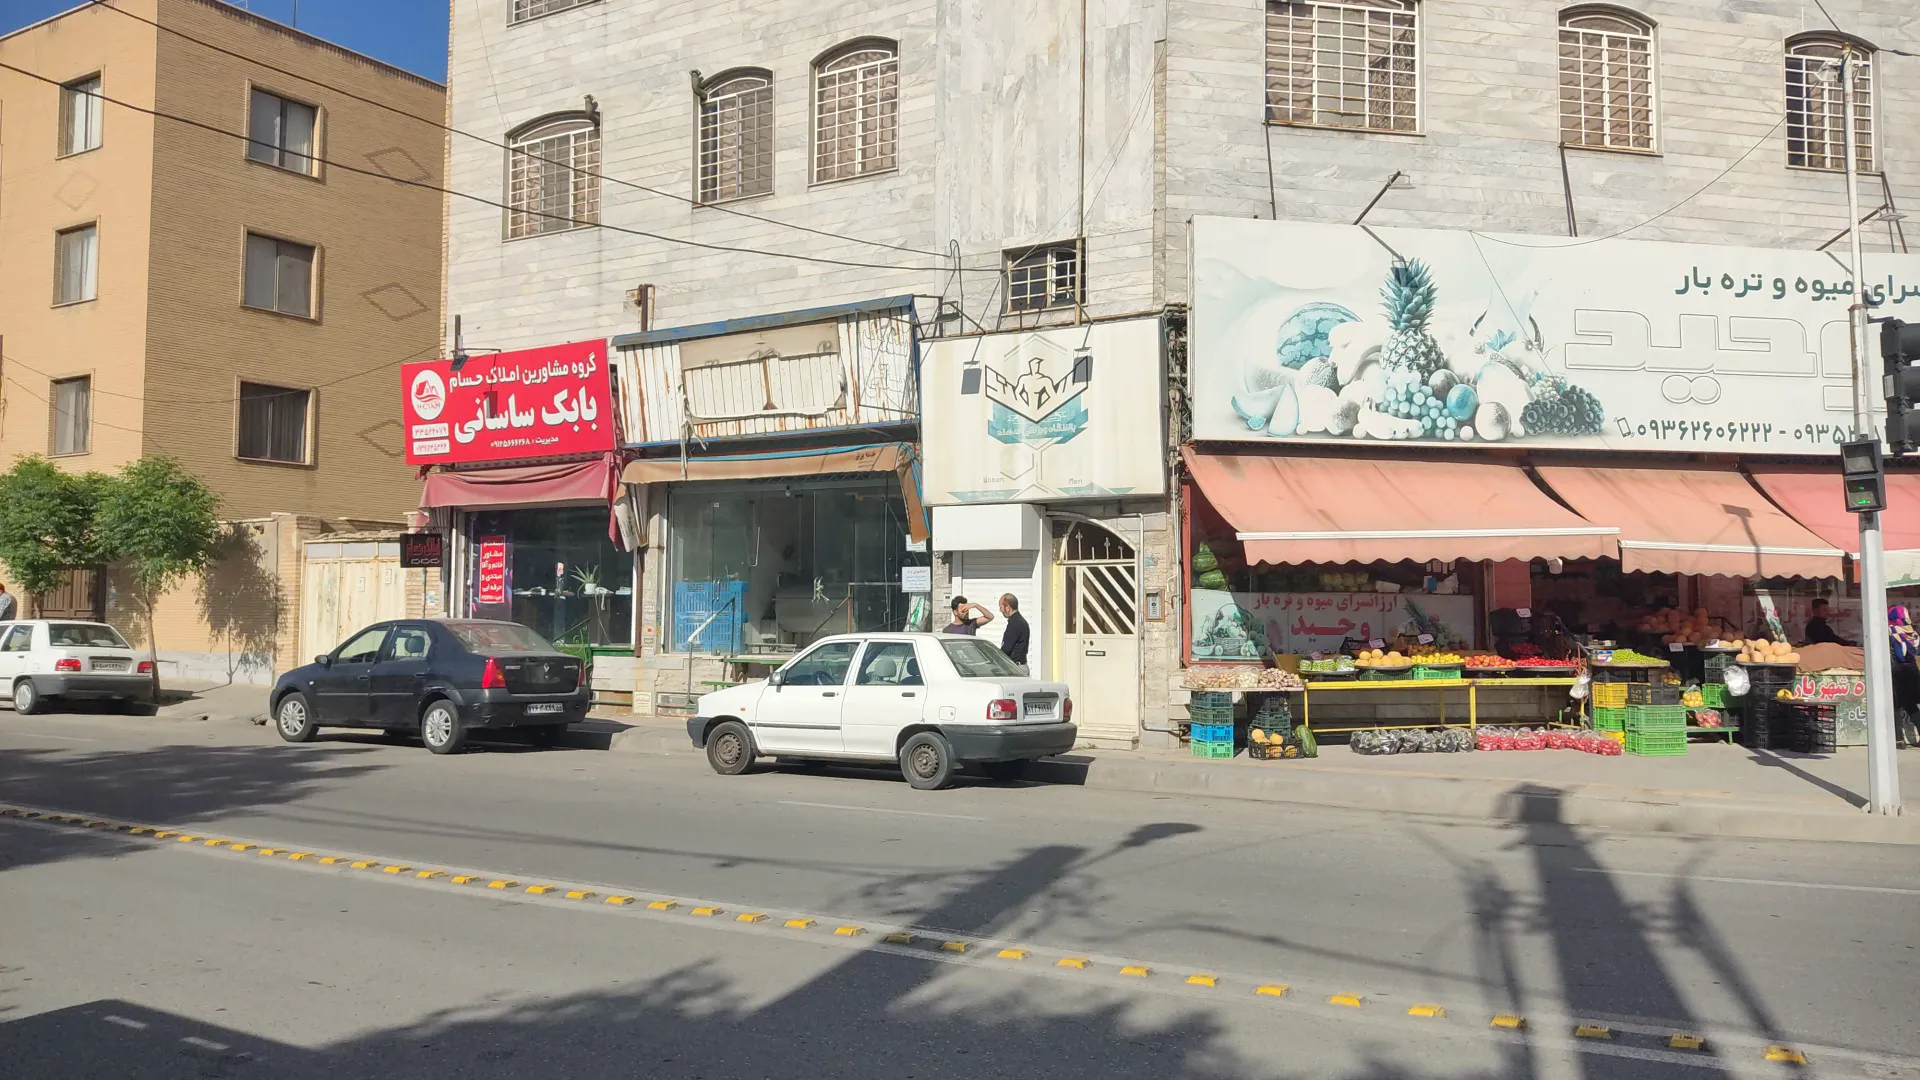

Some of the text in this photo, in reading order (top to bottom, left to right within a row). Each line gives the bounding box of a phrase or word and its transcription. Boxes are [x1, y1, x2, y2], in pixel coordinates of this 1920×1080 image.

[1675, 266, 1712, 297] بار
[1721, 271, 1763, 299] تره
[1773, 279, 1787, 300] و
[1795, 276, 1854, 302] میوه
[449, 351, 597, 393] گروه مشاورین املاک حسام
[454, 386, 598, 444] بابک ساسانی
[1637, 420, 1772, 444] ۰۹۳۶۲۶۰۶۲۲۲
[1069, 477, 1083, 485] Men
[1253, 592, 1398, 613] ارزانسرای میوه و تره بار
[1290, 615, 1371, 642] وحید
